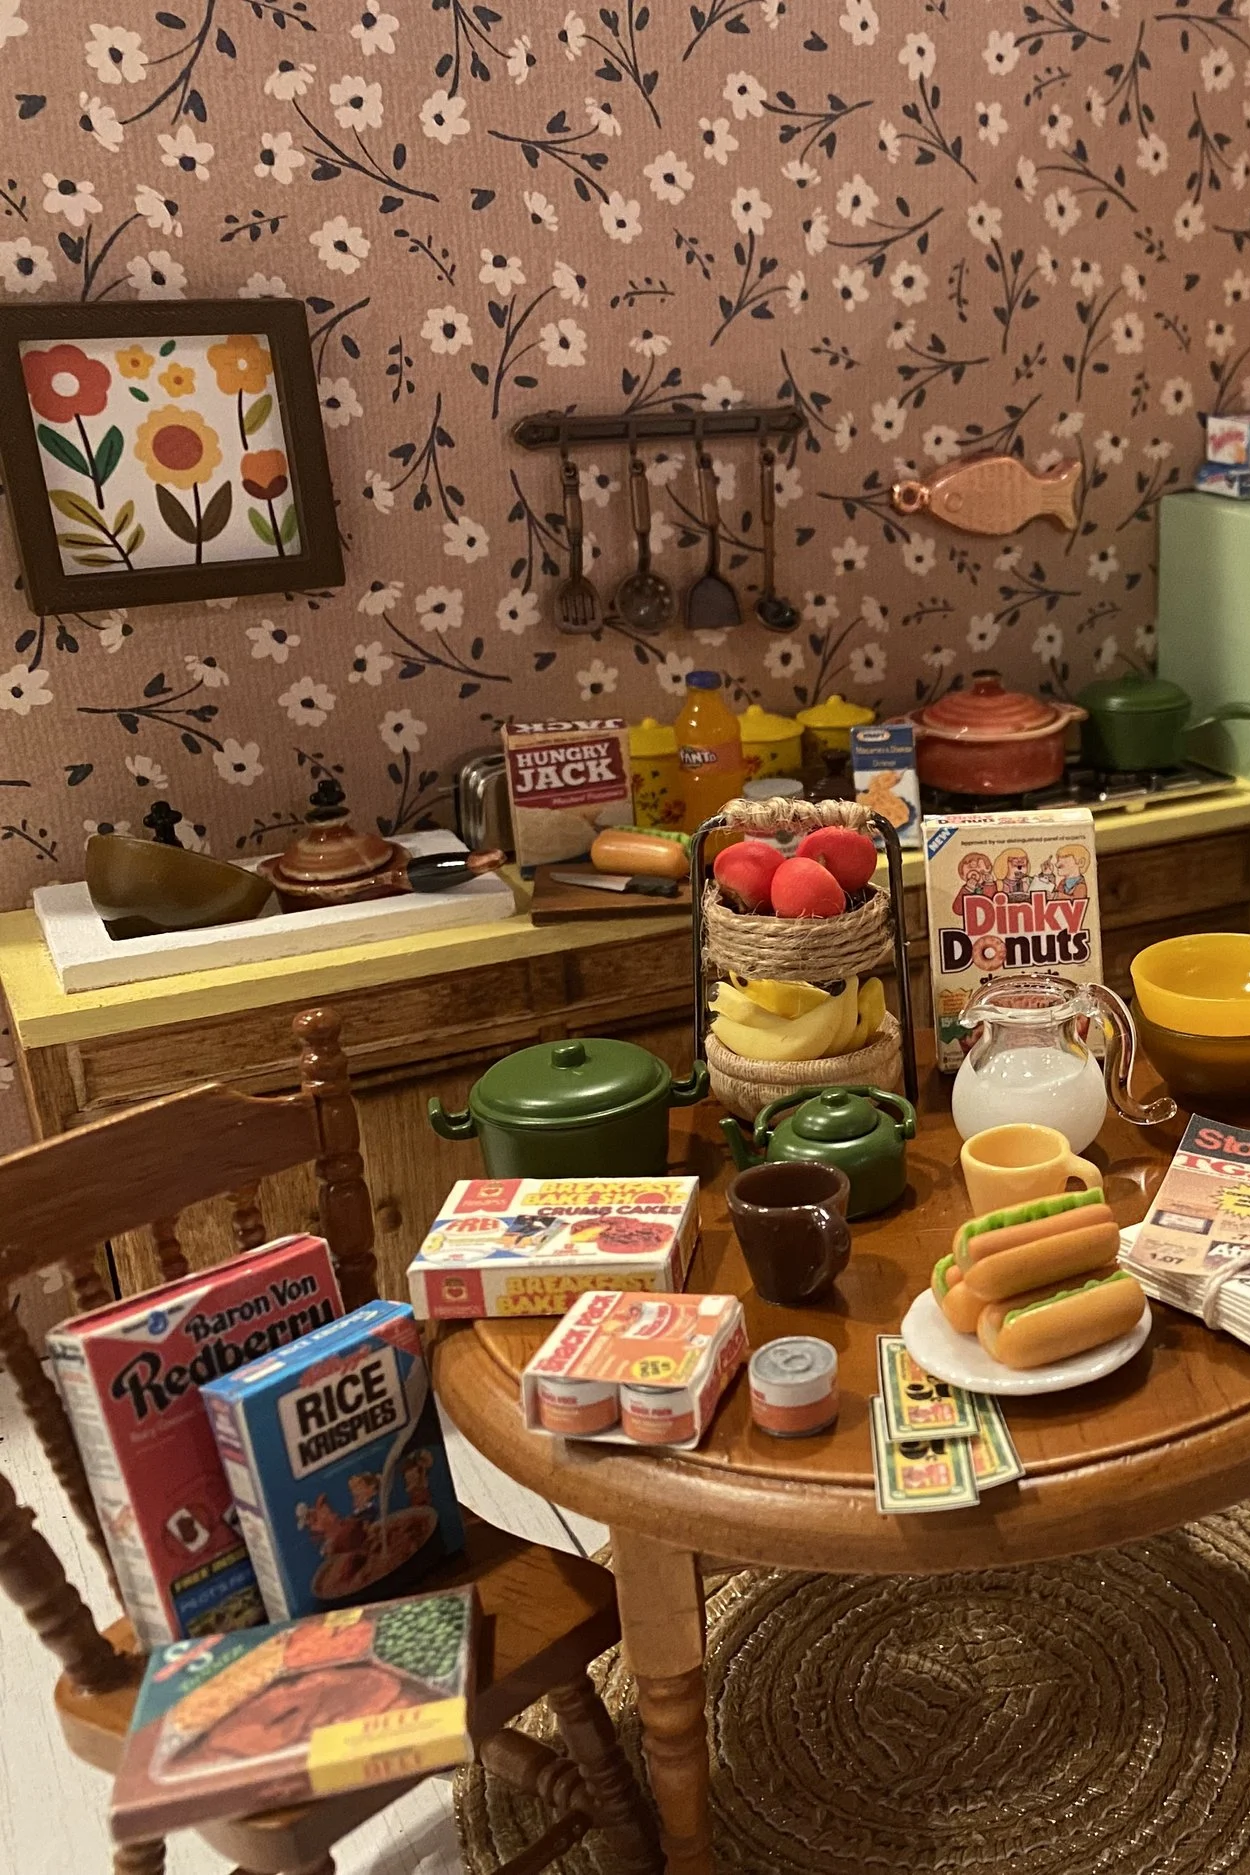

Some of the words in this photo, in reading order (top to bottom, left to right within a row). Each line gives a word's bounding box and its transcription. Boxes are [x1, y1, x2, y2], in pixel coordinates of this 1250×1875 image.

[512, 718, 623, 733] JACK
[516, 742, 610, 768] HUNGRY
[516, 758, 617, 793] JACK
[928, 827, 952, 852] NEW
[962, 890, 1089, 936] Dinky
[938, 928, 1091, 975] Donuts
[520, 1192, 586, 1206] BAKE
[540, 1181, 685, 1196] BREAKFAST
[536, 1205, 613, 1217] CRUMB
[615, 1204, 684, 1216] CAKES
[1149, 1252, 1185, 1266] 1.07
[505, 1274, 655, 1297] BREAKFAST
[185, 1291, 271, 1344] Baron
[268, 1273, 318, 1308] Von
[495, 1294, 567, 1316] BAKE
[574, 1294, 617, 1327] Pack
[111, 1298, 336, 1421] Redberry
[532, 1328, 592, 1373] Snack
[295, 1359, 388, 1437] RICE
[297, 1398, 397, 1468] KRISPIES
